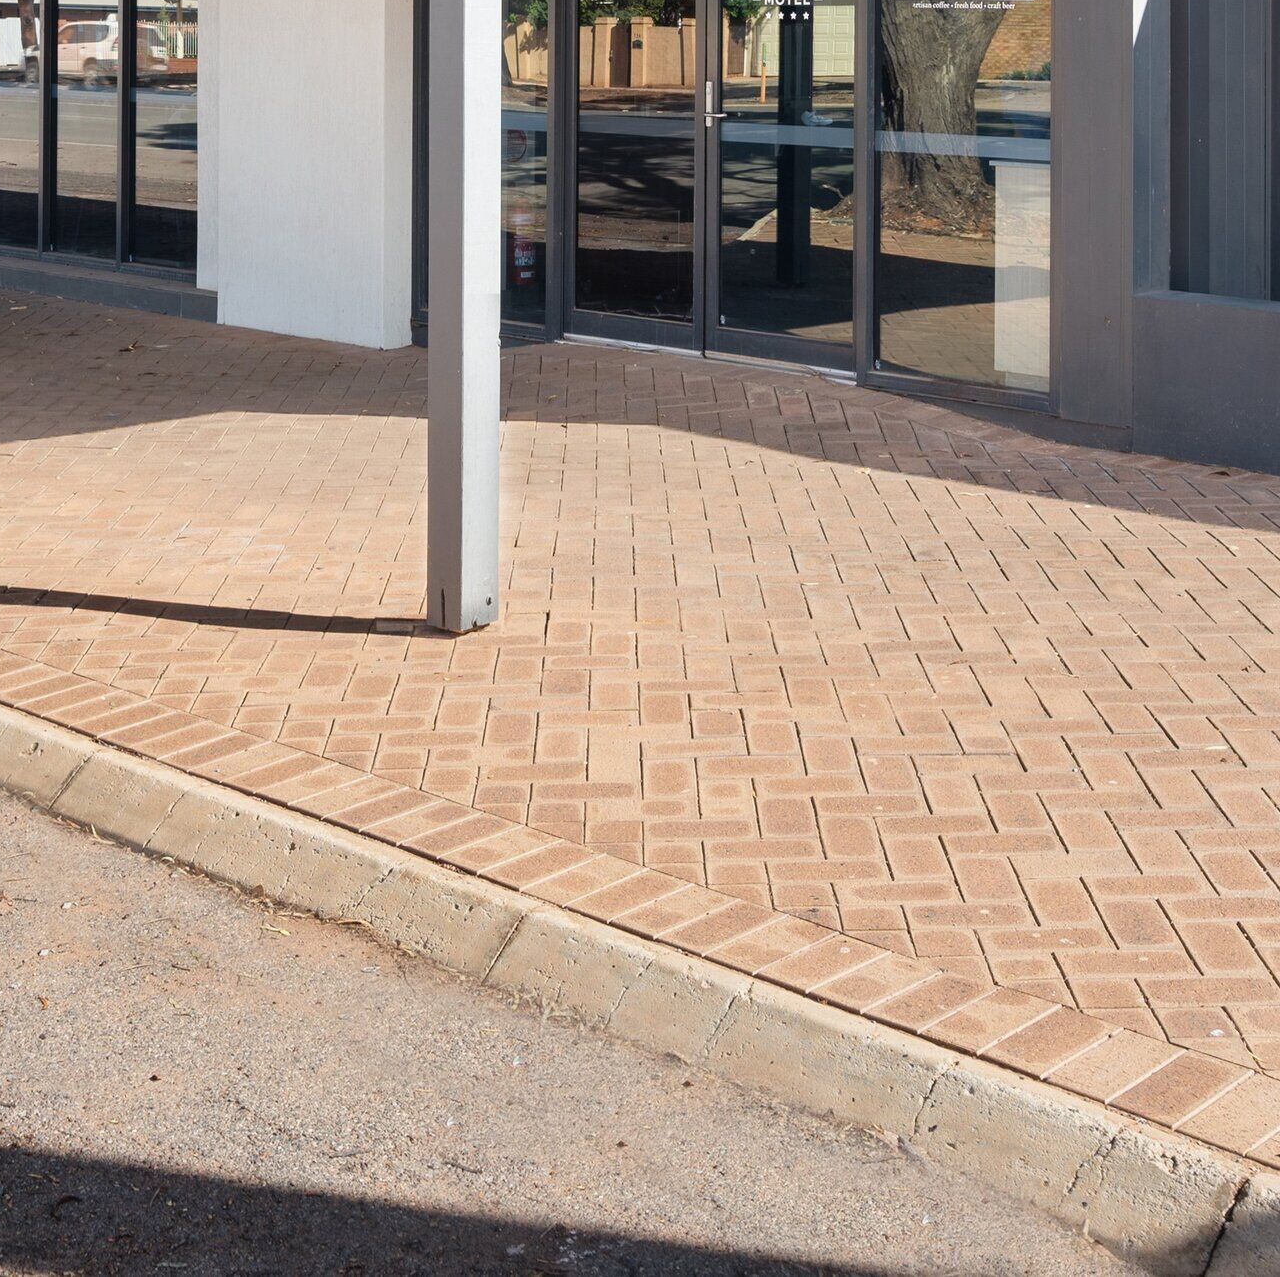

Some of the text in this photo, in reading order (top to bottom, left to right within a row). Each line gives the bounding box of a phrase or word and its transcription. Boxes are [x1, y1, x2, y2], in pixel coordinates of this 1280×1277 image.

[933, 1, 950, 9] coffee
[954, 1, 969, 9] fresh
[970, 1, 984, 9] food
[987, 1, 1001, 10] craft
[1002, 1, 1016, 10] beer
